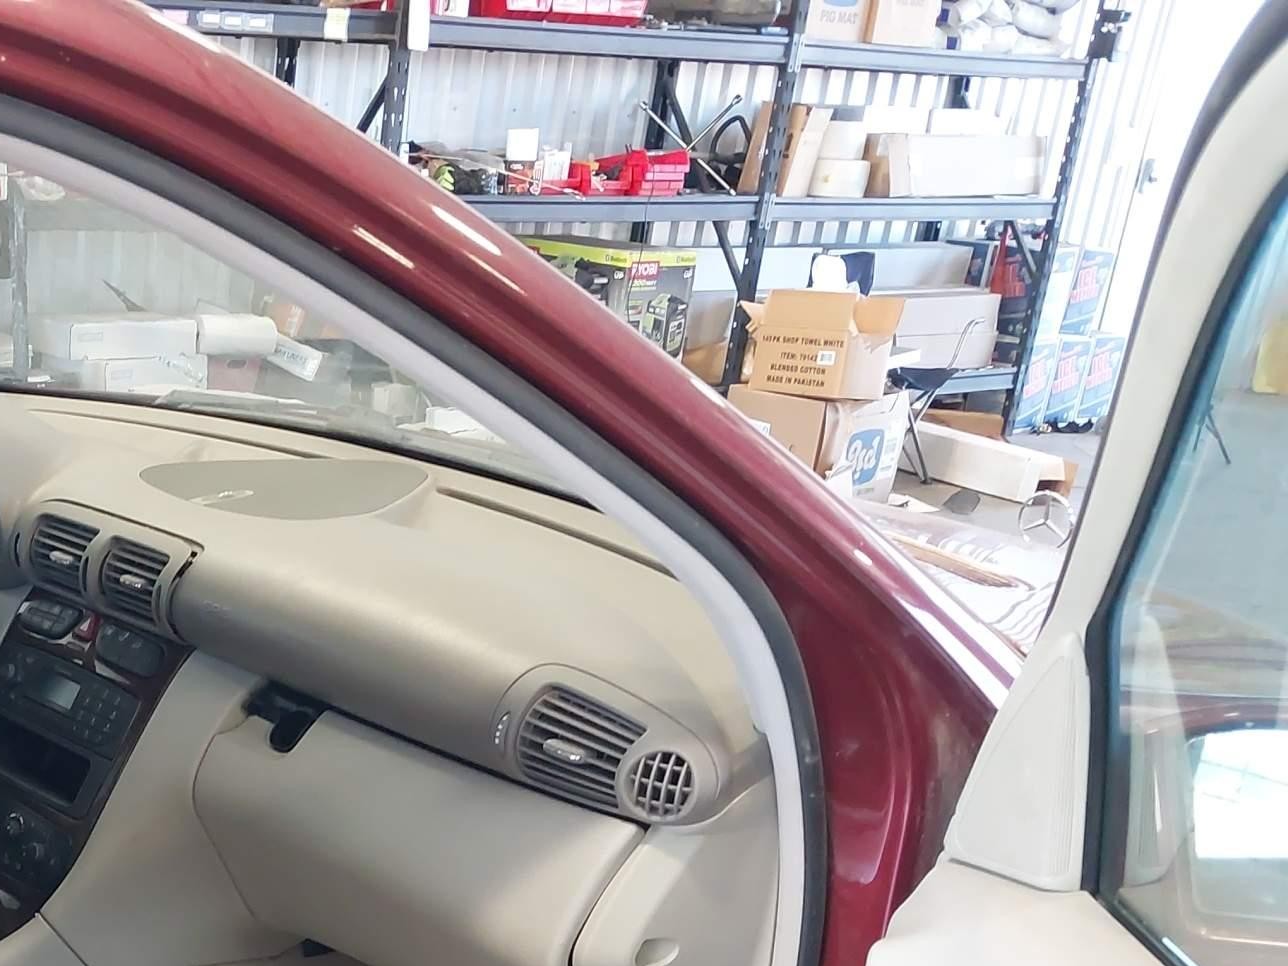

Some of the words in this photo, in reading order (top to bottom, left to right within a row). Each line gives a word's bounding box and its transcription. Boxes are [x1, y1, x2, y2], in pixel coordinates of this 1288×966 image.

[631, 263, 659, 278] RYOBI
[782, 336, 799, 345] SHOP
[801, 337, 822, 347] TOWEL
[823, 339, 844, 349] WHITE
[800, 366, 826, 376] COTTON
[766, 375, 783, 384] MADE
[785, 376, 792, 384] IN
[793, 378, 825, 388] PAKISTAN
